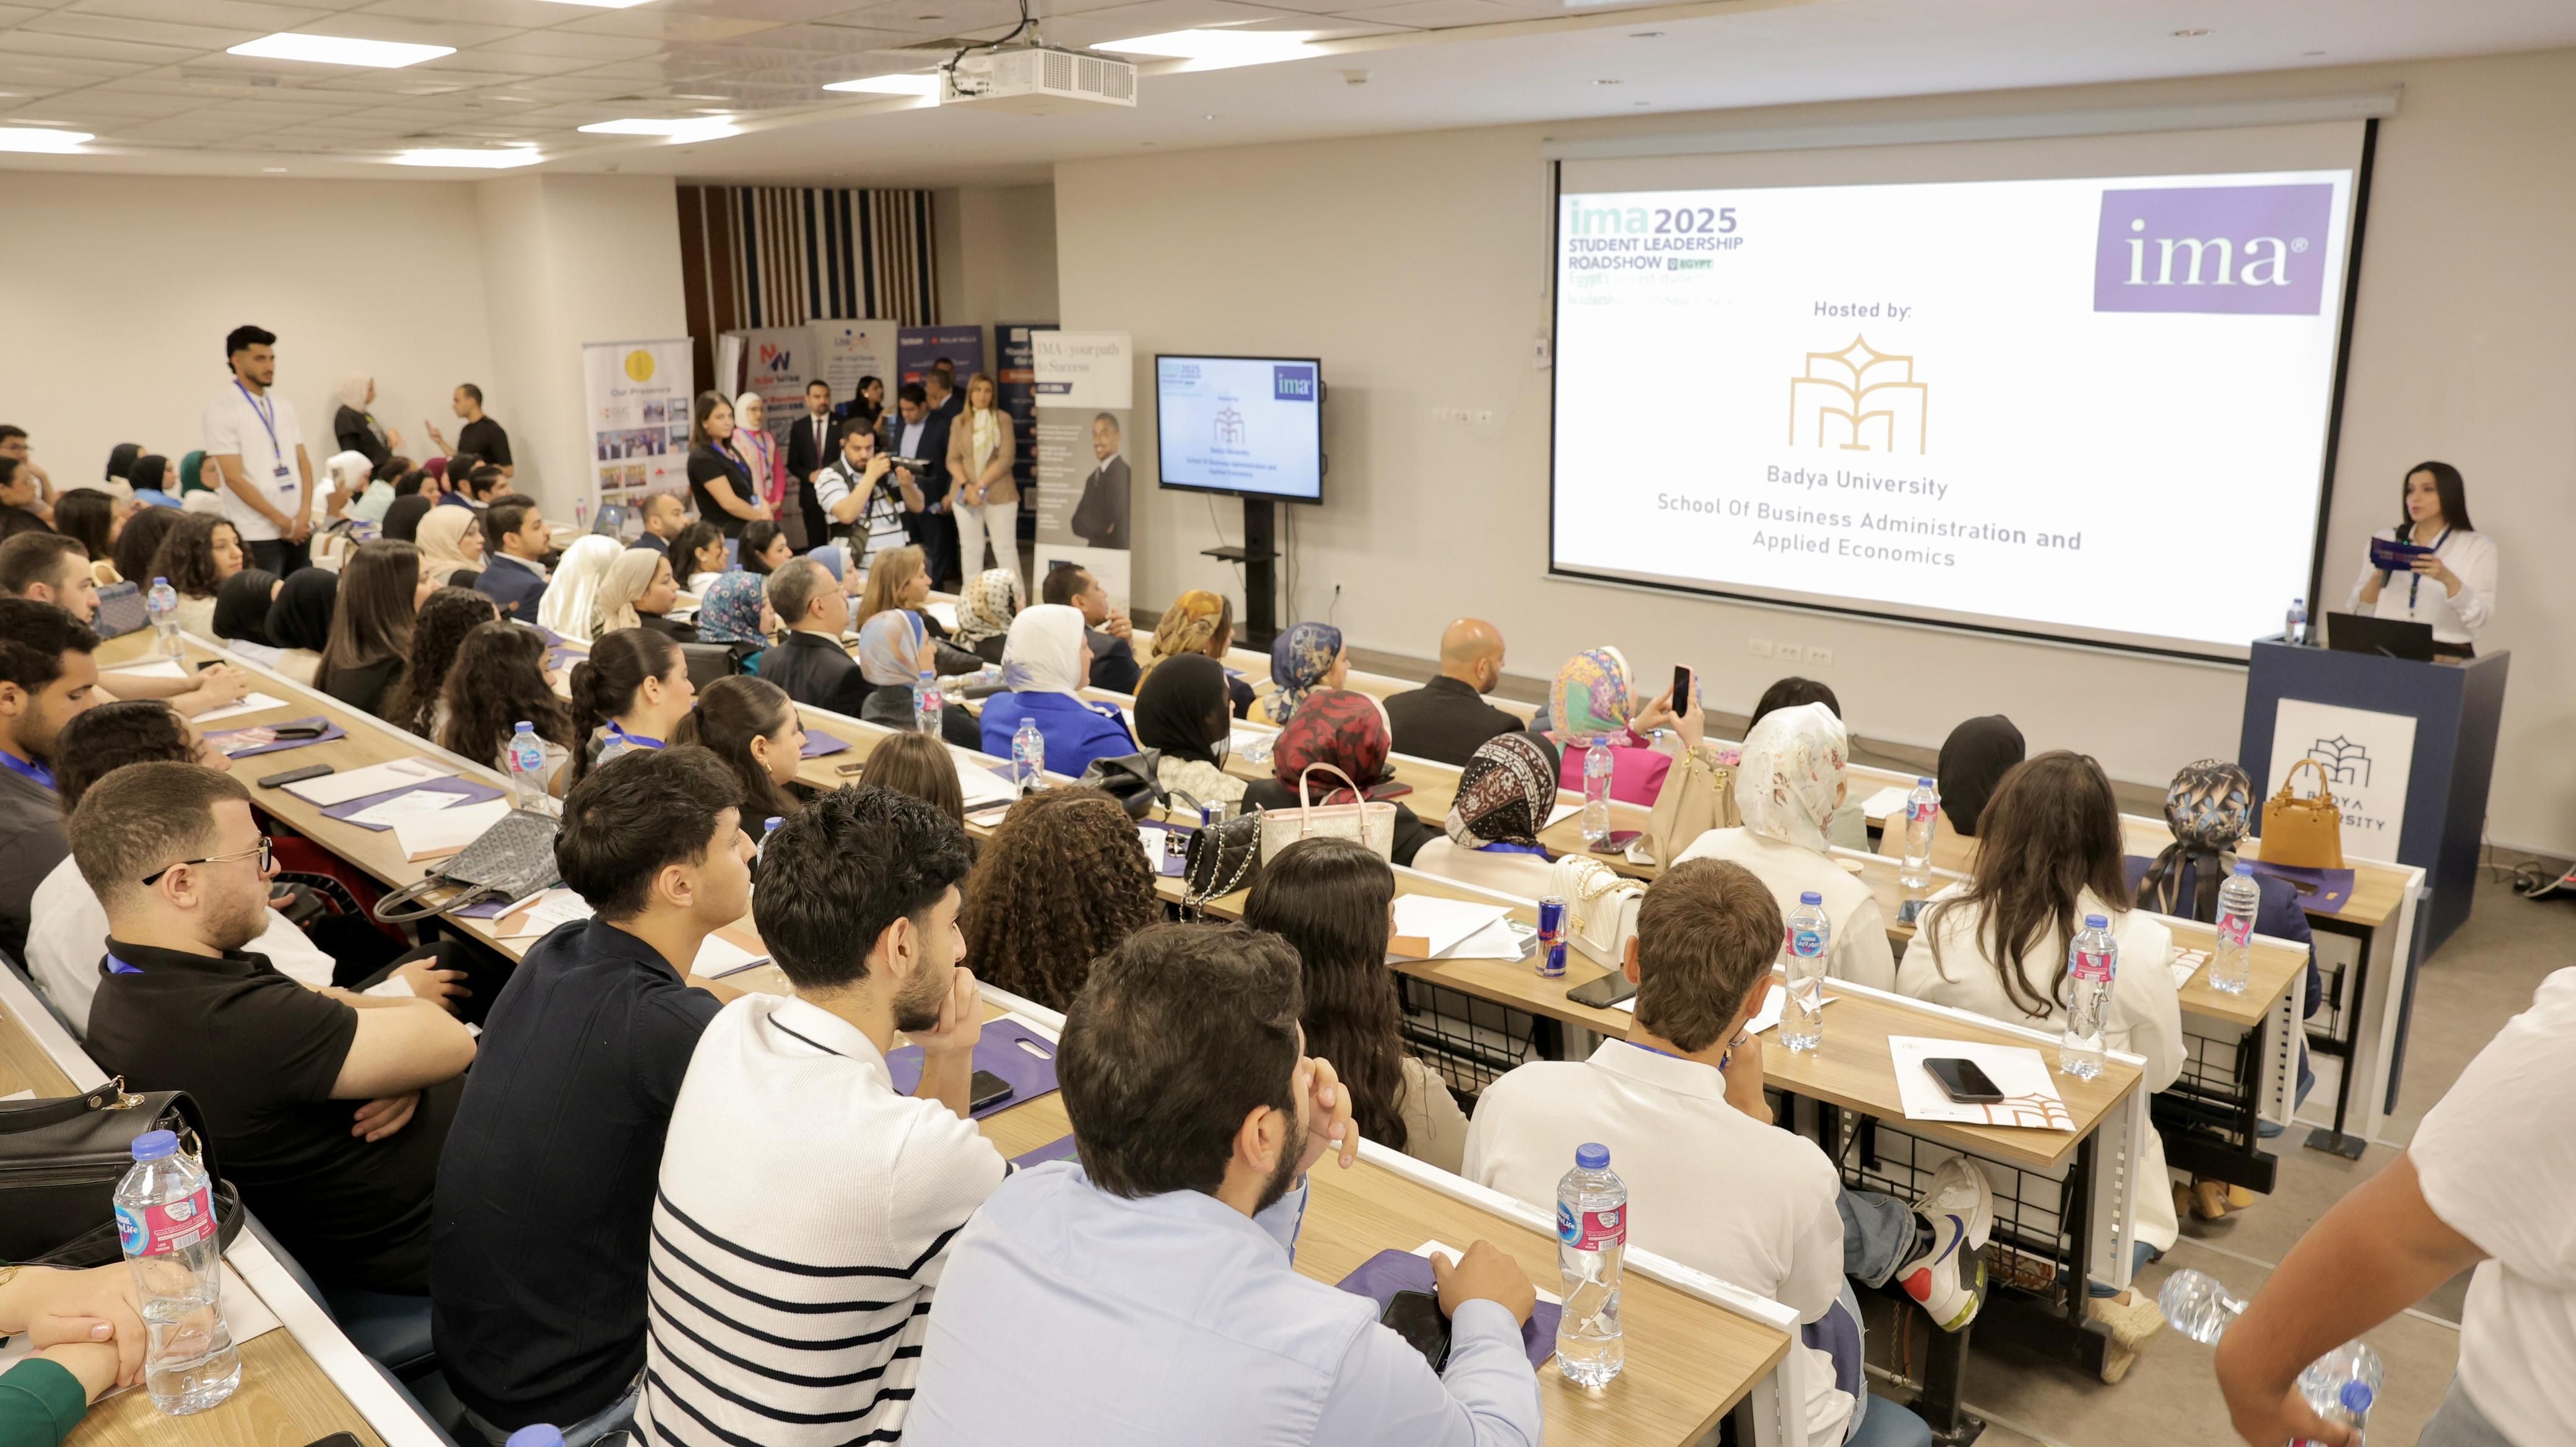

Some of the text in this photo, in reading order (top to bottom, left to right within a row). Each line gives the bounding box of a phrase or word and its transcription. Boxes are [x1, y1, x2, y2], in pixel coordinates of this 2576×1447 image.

[1570, 199, 1737, 235] ima 2025
[1569, 237, 1744, 252] STUDENT LEADERSHIP
[1569, 256, 1712, 269] ROADSHOW EGYPT
[1815, 301, 1912, 322] Hosted by:
[1767, 466, 1948, 499] Badya University
[1658, 493, 2082, 551] School Of Business Administration and
[1752, 530, 1956, 567] Applied Economics
